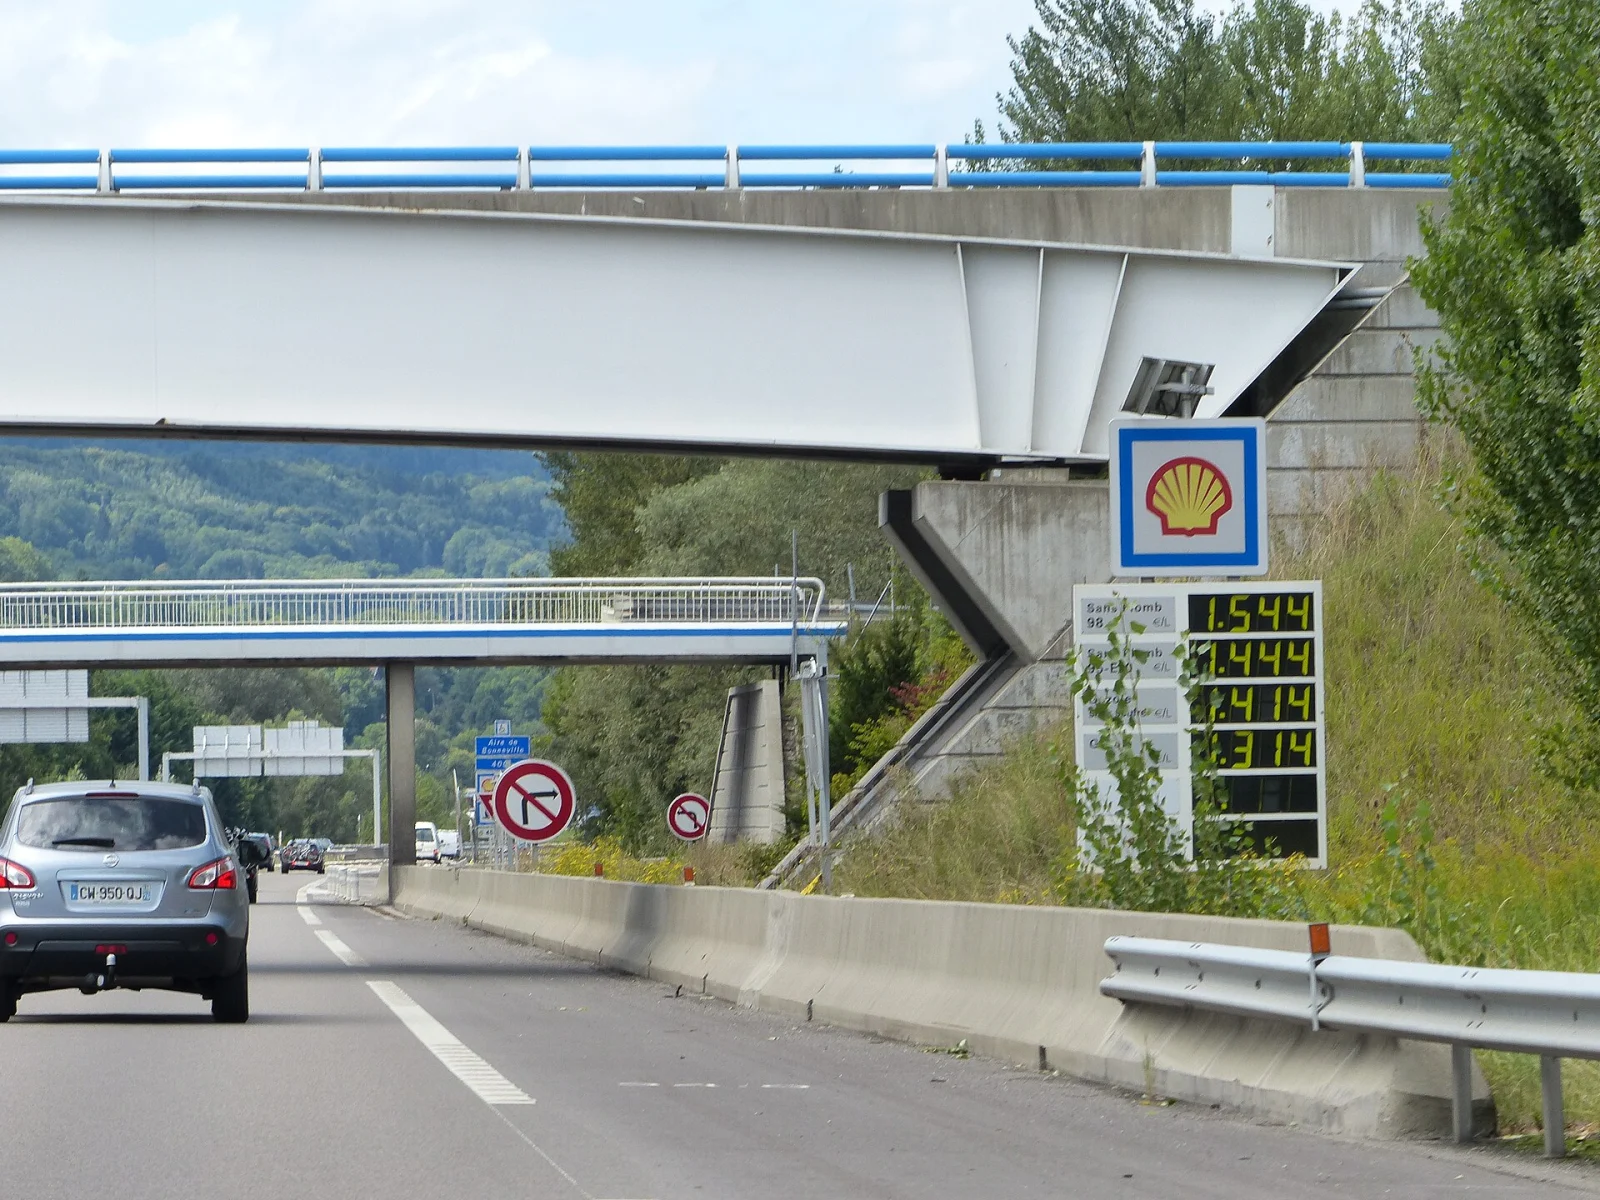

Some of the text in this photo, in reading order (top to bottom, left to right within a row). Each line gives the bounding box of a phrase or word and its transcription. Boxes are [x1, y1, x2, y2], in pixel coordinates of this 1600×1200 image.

[1087, 602, 1118, 614] Sans
[1207, 594, 1310, 633] 1.544
[1086, 616, 1104, 629] 98
[1123, 646, 1163, 658] Plmb
[1208, 640, 1311, 677] 1.444
[487, 738, 519, 747] Aire de
[481, 746, 525, 755] Bonneville
